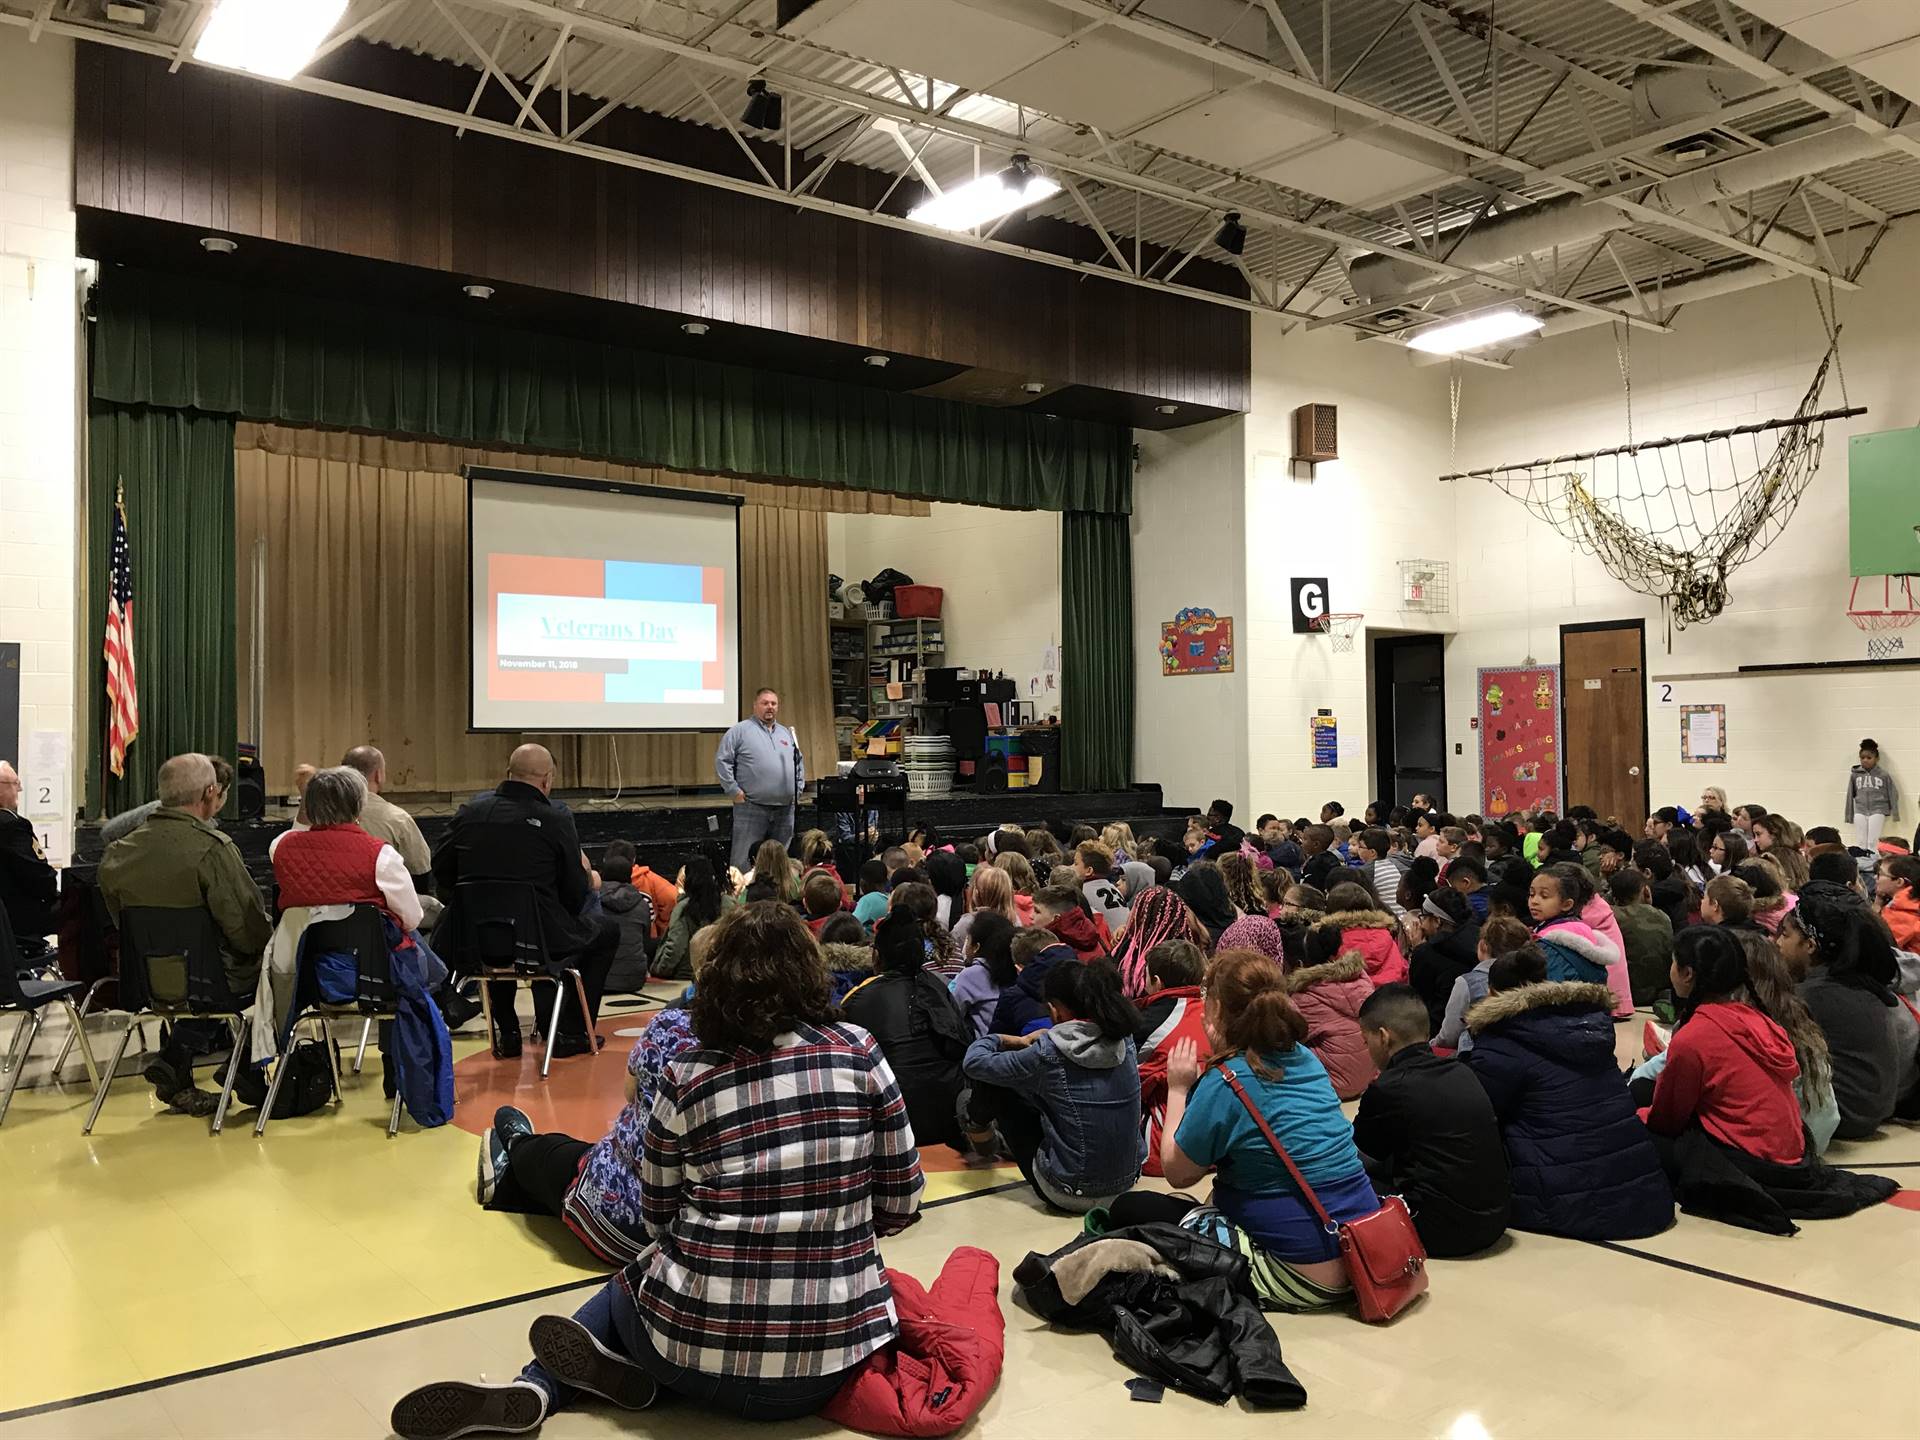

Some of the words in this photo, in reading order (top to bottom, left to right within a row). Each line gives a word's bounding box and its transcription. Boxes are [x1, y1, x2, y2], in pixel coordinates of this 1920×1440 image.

[1299, 583, 1323, 619] G
[541, 617, 633, 639] Veterans
[640, 621, 678, 643] Day
[499, 659, 546, 669] November
[548, 660, 557, 670] 11,
[1661, 684, 1672, 702] 2
[1855, 776, 1883, 790] GAP
[39, 787, 50, 803] 2
[42, 833, 50, 849] 1
